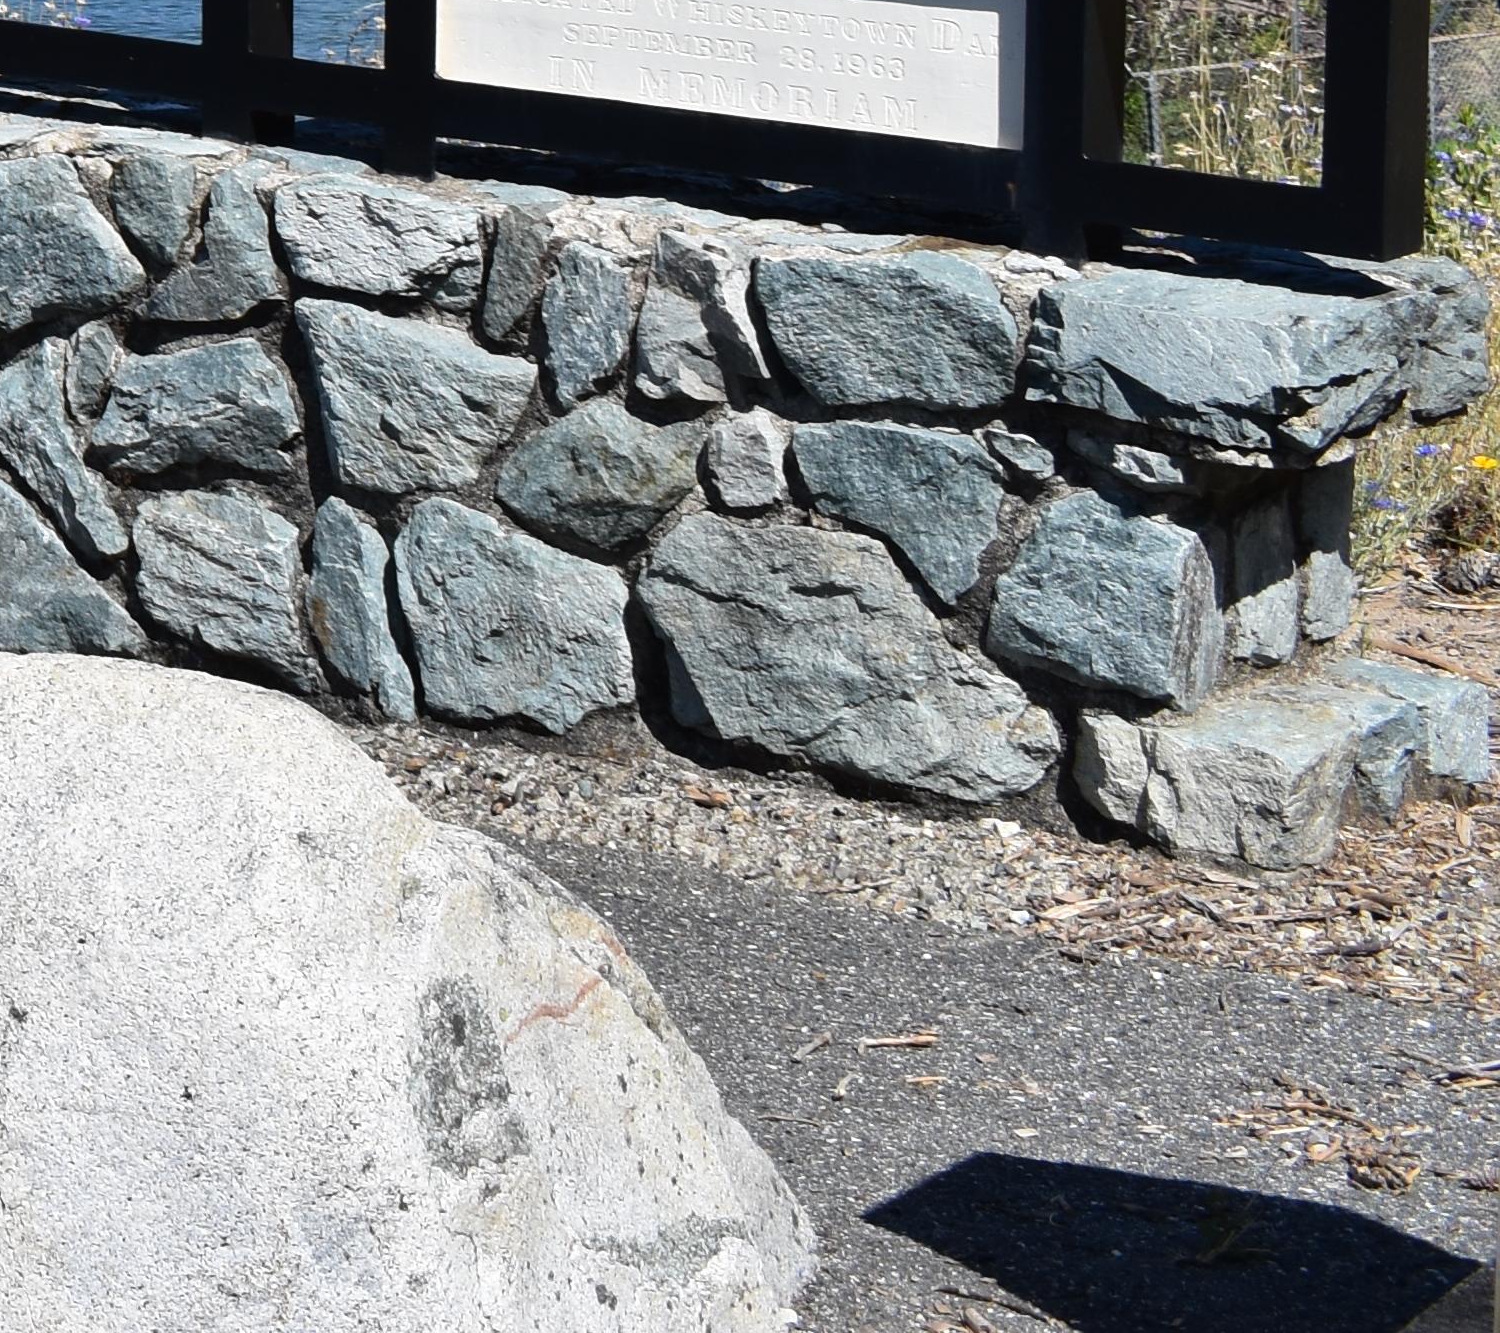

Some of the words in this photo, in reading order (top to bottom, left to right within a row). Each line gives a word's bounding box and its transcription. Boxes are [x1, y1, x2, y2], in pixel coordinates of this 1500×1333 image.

[562, 22, 757, 65] SEPTEMBER
[548, 55, 597, 93] IN
[637, 66, 918, 132] MEMORIAM
